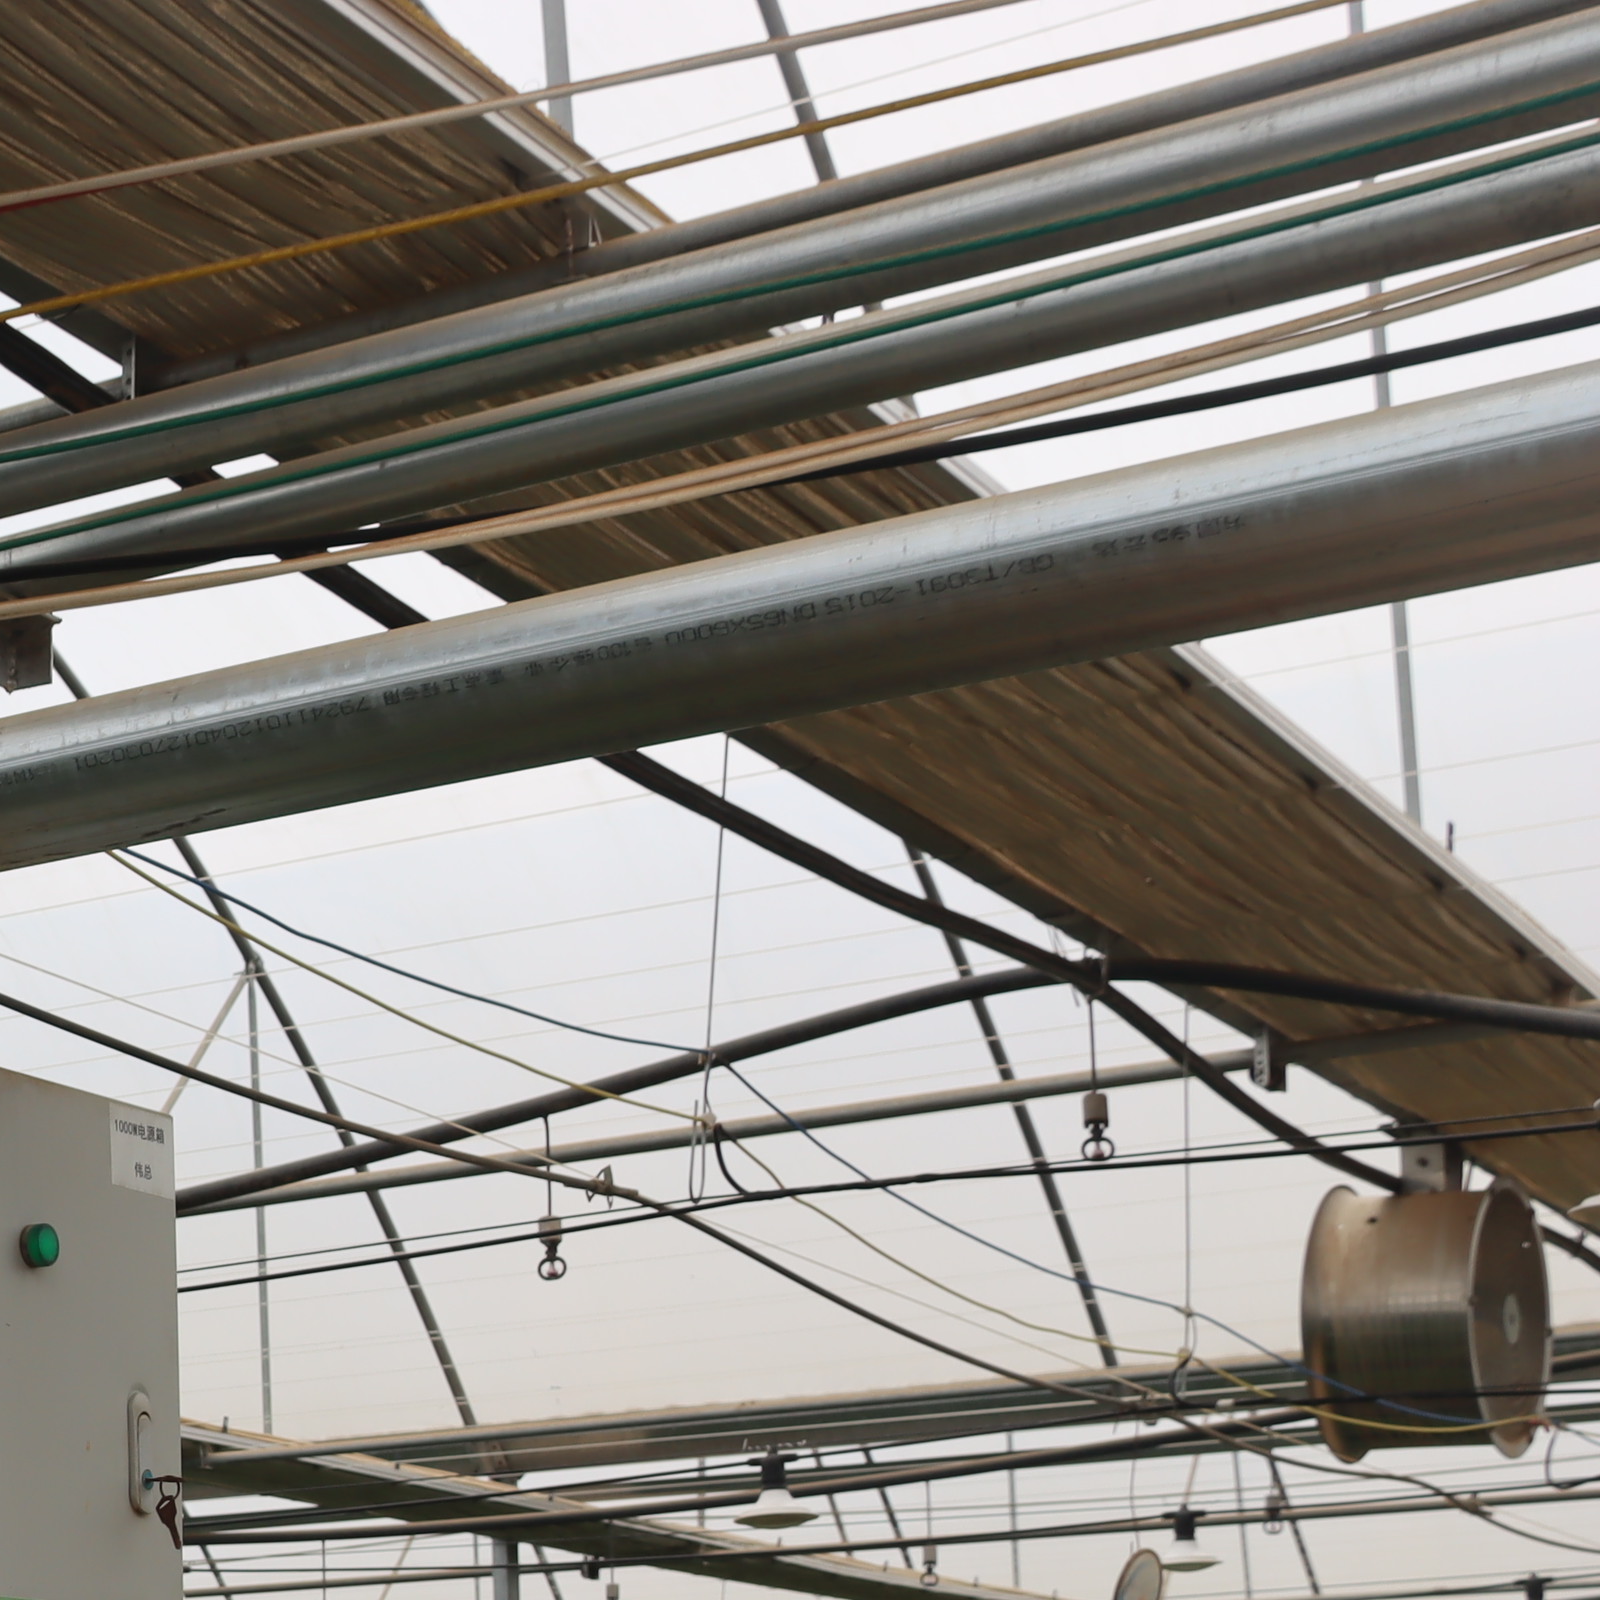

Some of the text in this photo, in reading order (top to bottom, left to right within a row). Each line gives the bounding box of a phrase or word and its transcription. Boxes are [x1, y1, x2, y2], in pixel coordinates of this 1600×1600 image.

[825, 552, 1054, 615] GB/T3091-2015
[114, 1119, 164, 1144] 1000W电源箱
